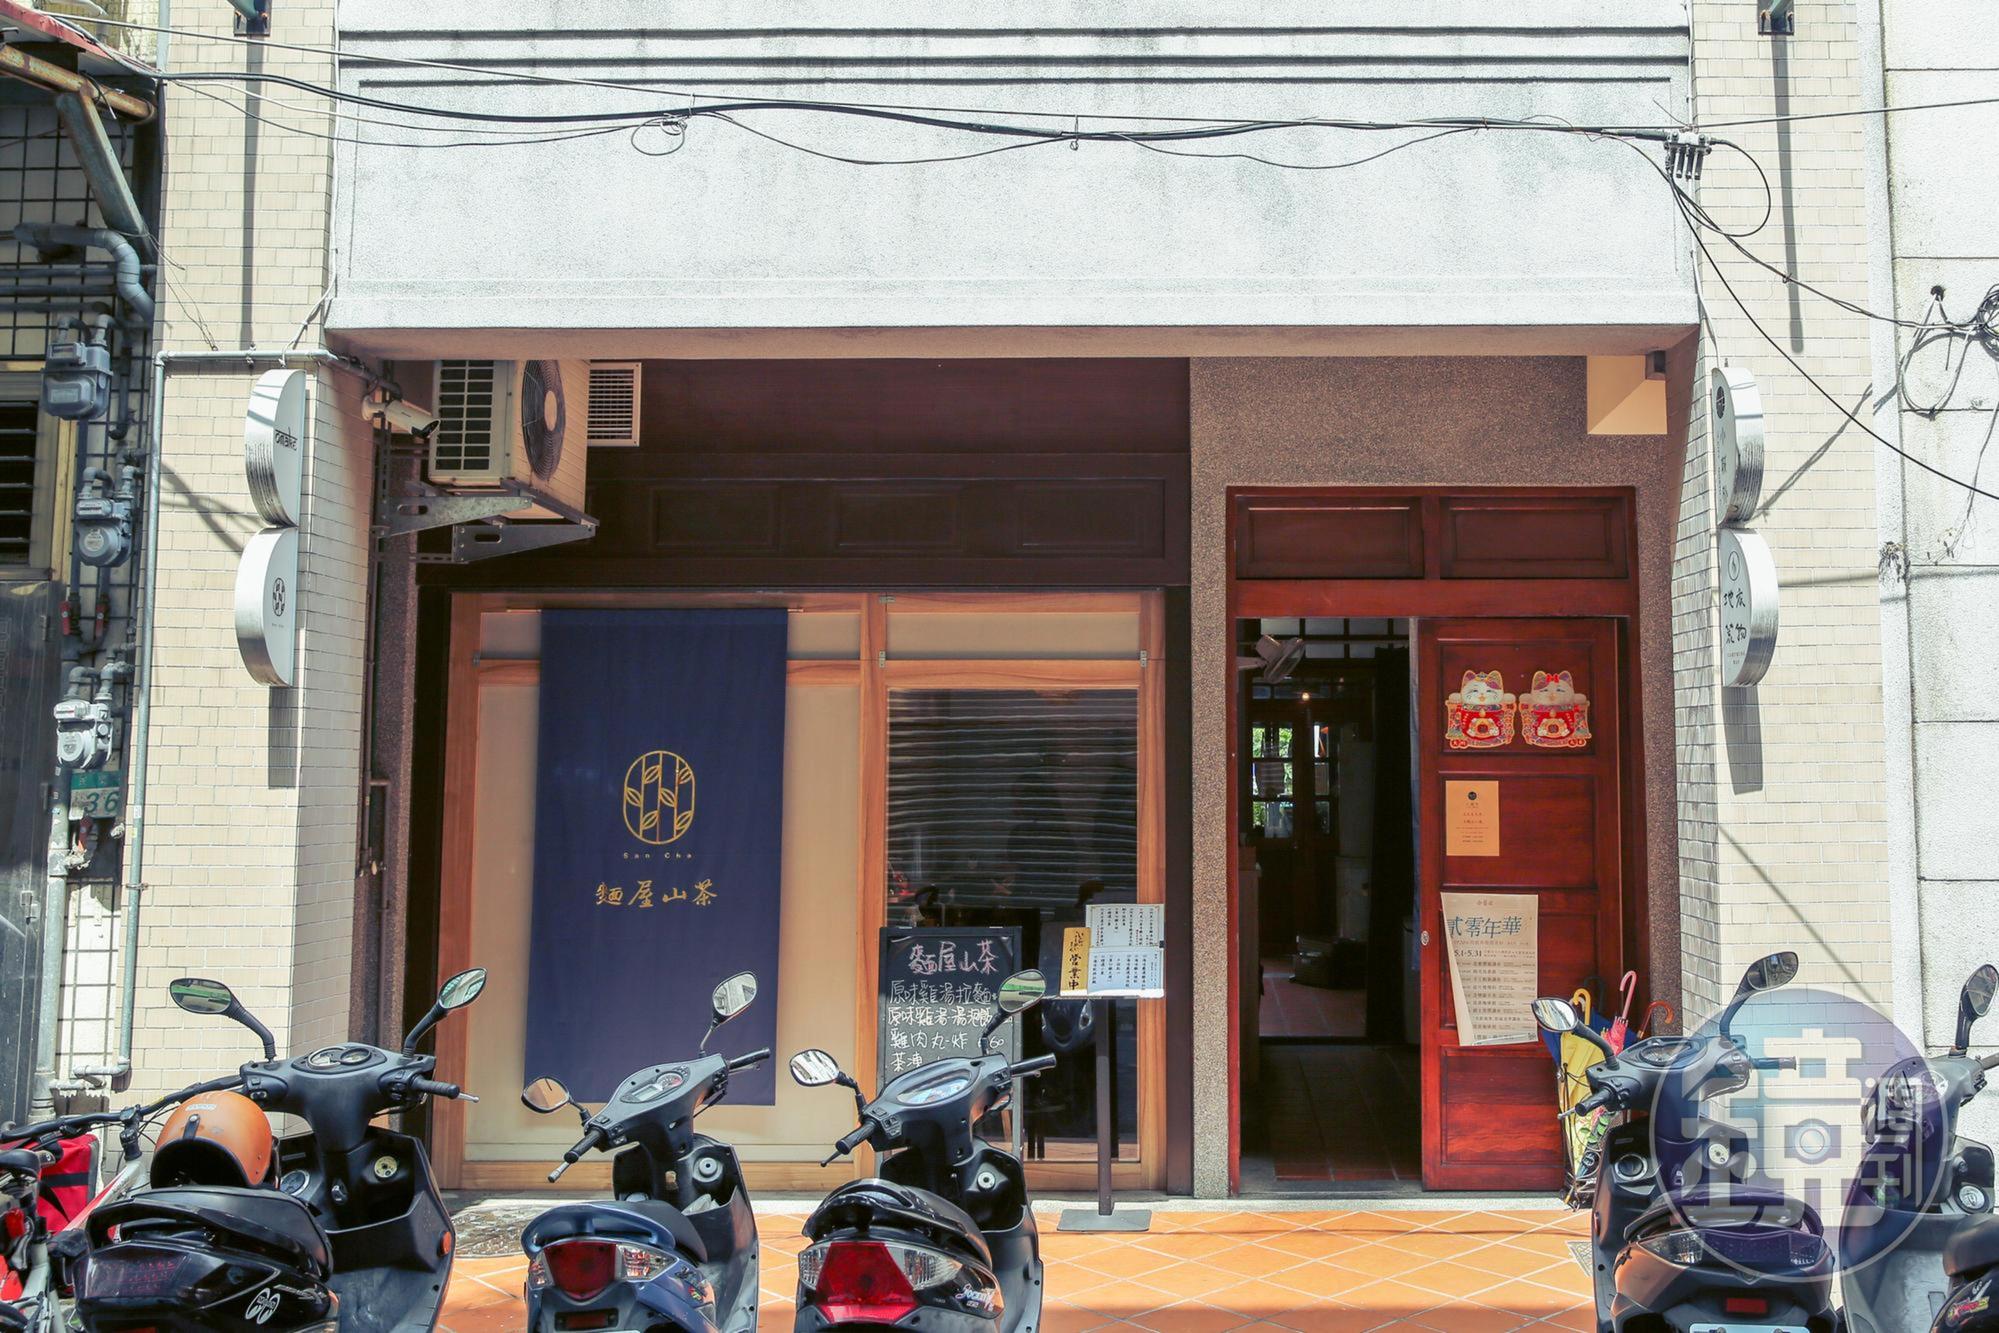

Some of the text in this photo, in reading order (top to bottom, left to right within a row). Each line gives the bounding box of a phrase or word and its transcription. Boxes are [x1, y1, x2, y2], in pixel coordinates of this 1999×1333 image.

[84, 791, 119, 813] 36
[908, 939, 999, 975] 麵屋山茶
